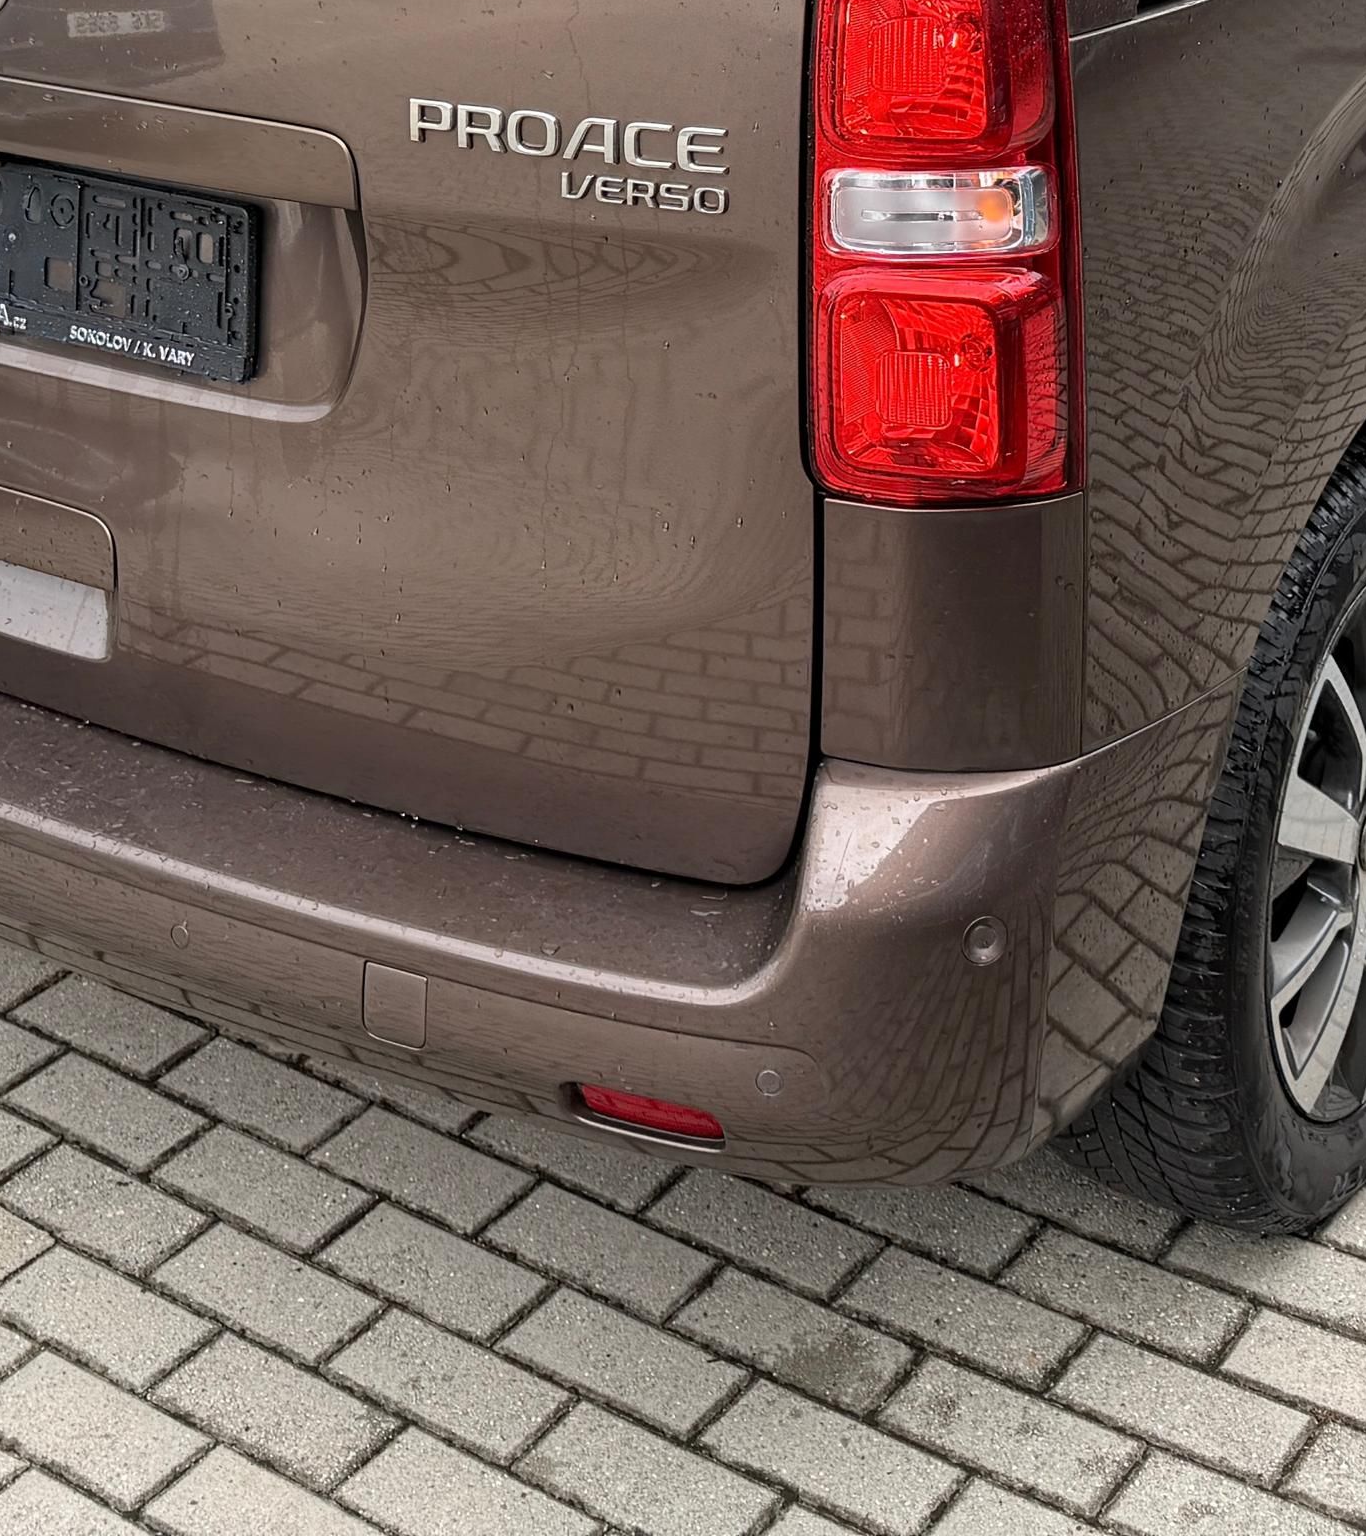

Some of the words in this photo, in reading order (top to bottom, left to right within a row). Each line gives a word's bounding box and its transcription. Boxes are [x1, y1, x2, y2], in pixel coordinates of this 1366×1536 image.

[409, 98, 730, 175] PROACE
[561, 171, 730, 214] VERSO
[69, 325, 132, 352] SOKOLOV
[142, 342, 156, 358] K.
[158, 345, 195, 366] VARY
